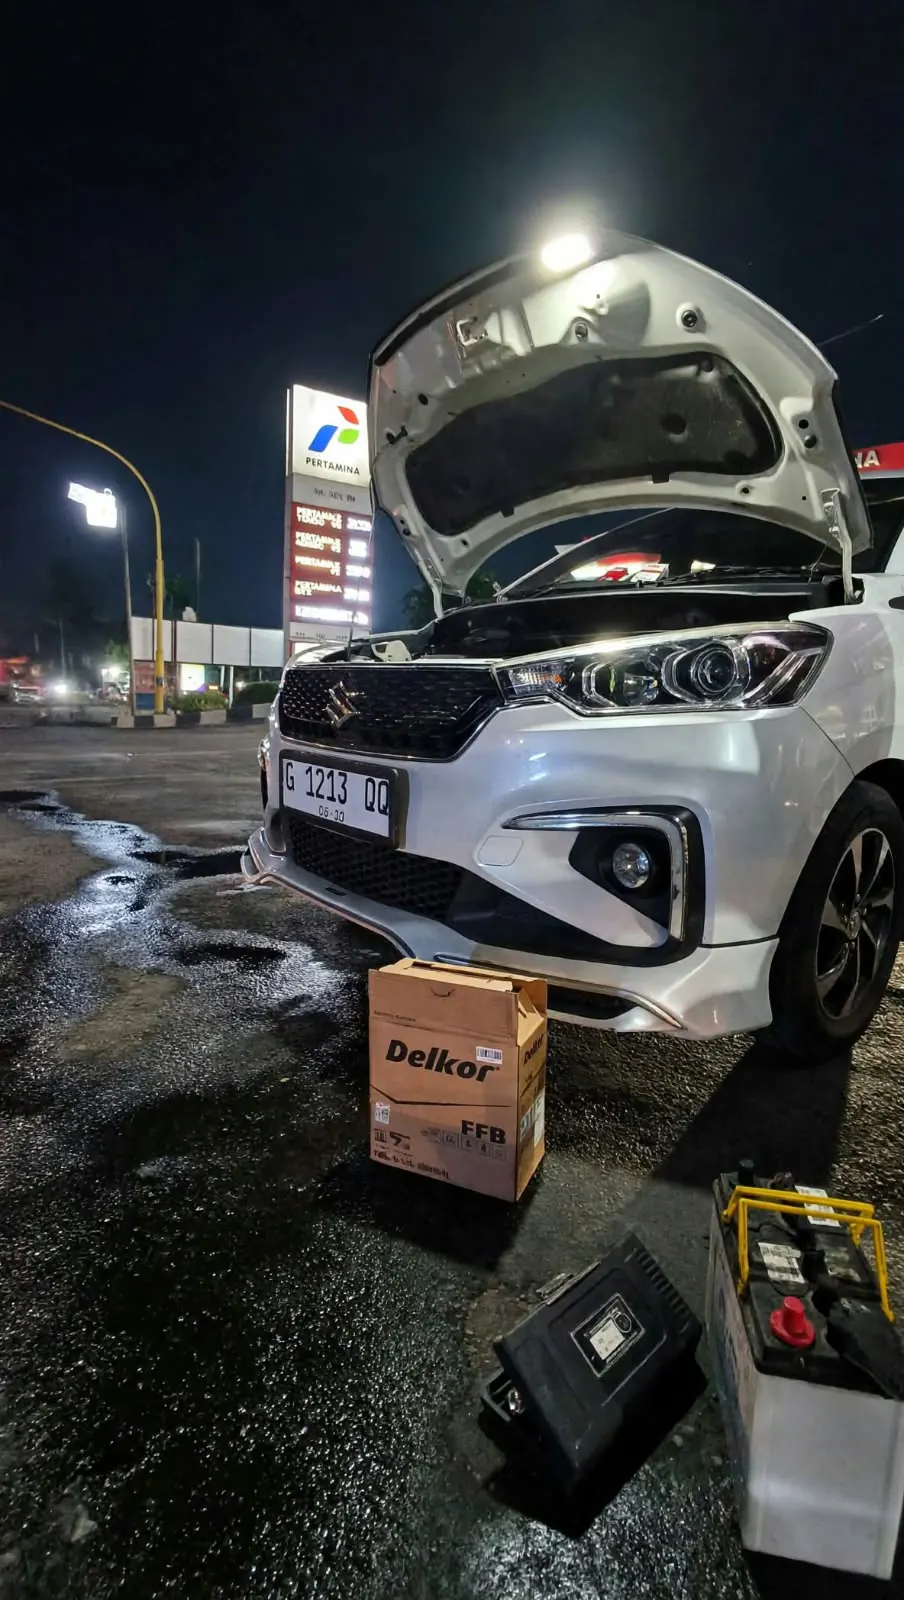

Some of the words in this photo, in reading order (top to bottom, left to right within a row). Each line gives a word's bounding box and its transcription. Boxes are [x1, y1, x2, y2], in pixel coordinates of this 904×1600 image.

[305, 457, 360, 475] PERTAMINA
[286, 762, 295, 791] G
[305, 766, 348, 804] 1213
[365, 777, 389, 816] QQ
[385, 1039, 495, 1082] Delkor
[461, 1120, 506, 1144] FFB
